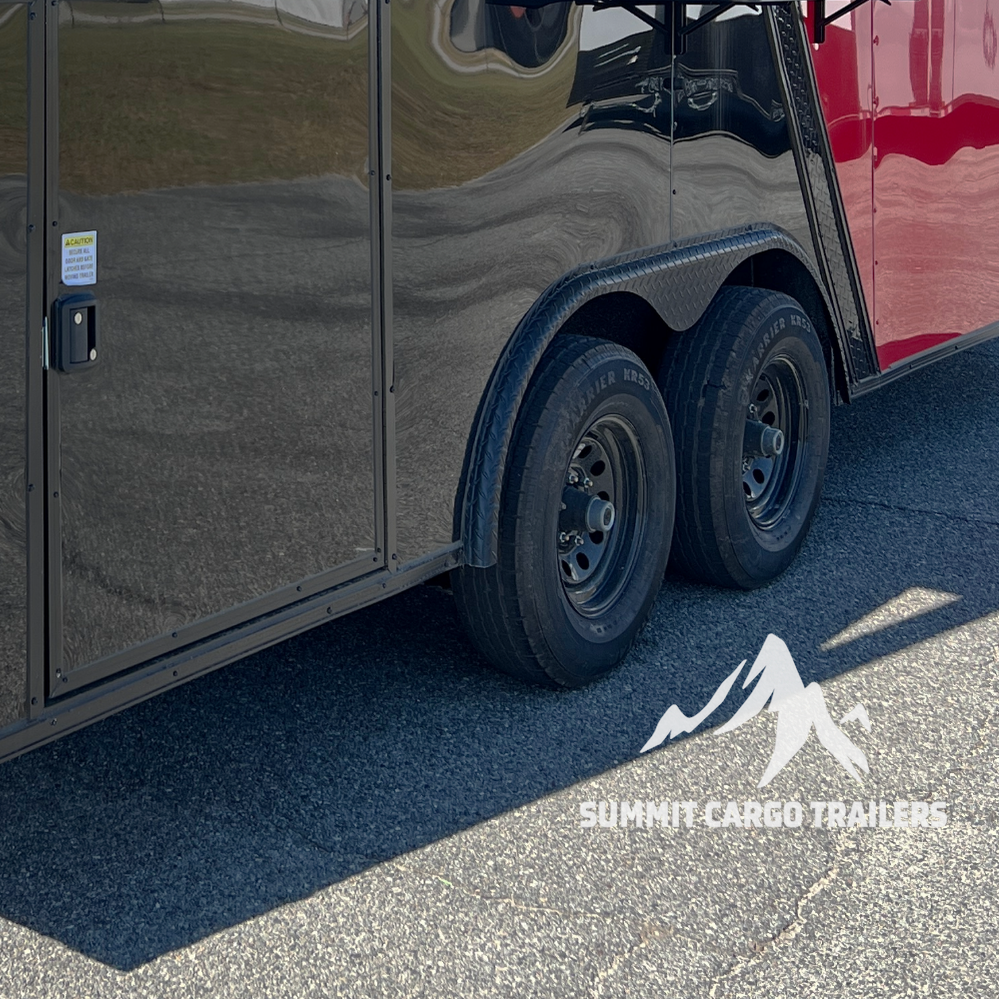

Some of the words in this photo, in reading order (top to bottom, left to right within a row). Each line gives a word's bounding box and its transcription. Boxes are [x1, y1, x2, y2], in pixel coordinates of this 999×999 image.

[70, 237, 93, 246] CAUTION
[790, 314, 811, 333] KR53
[623, 368, 651, 391] KR53
